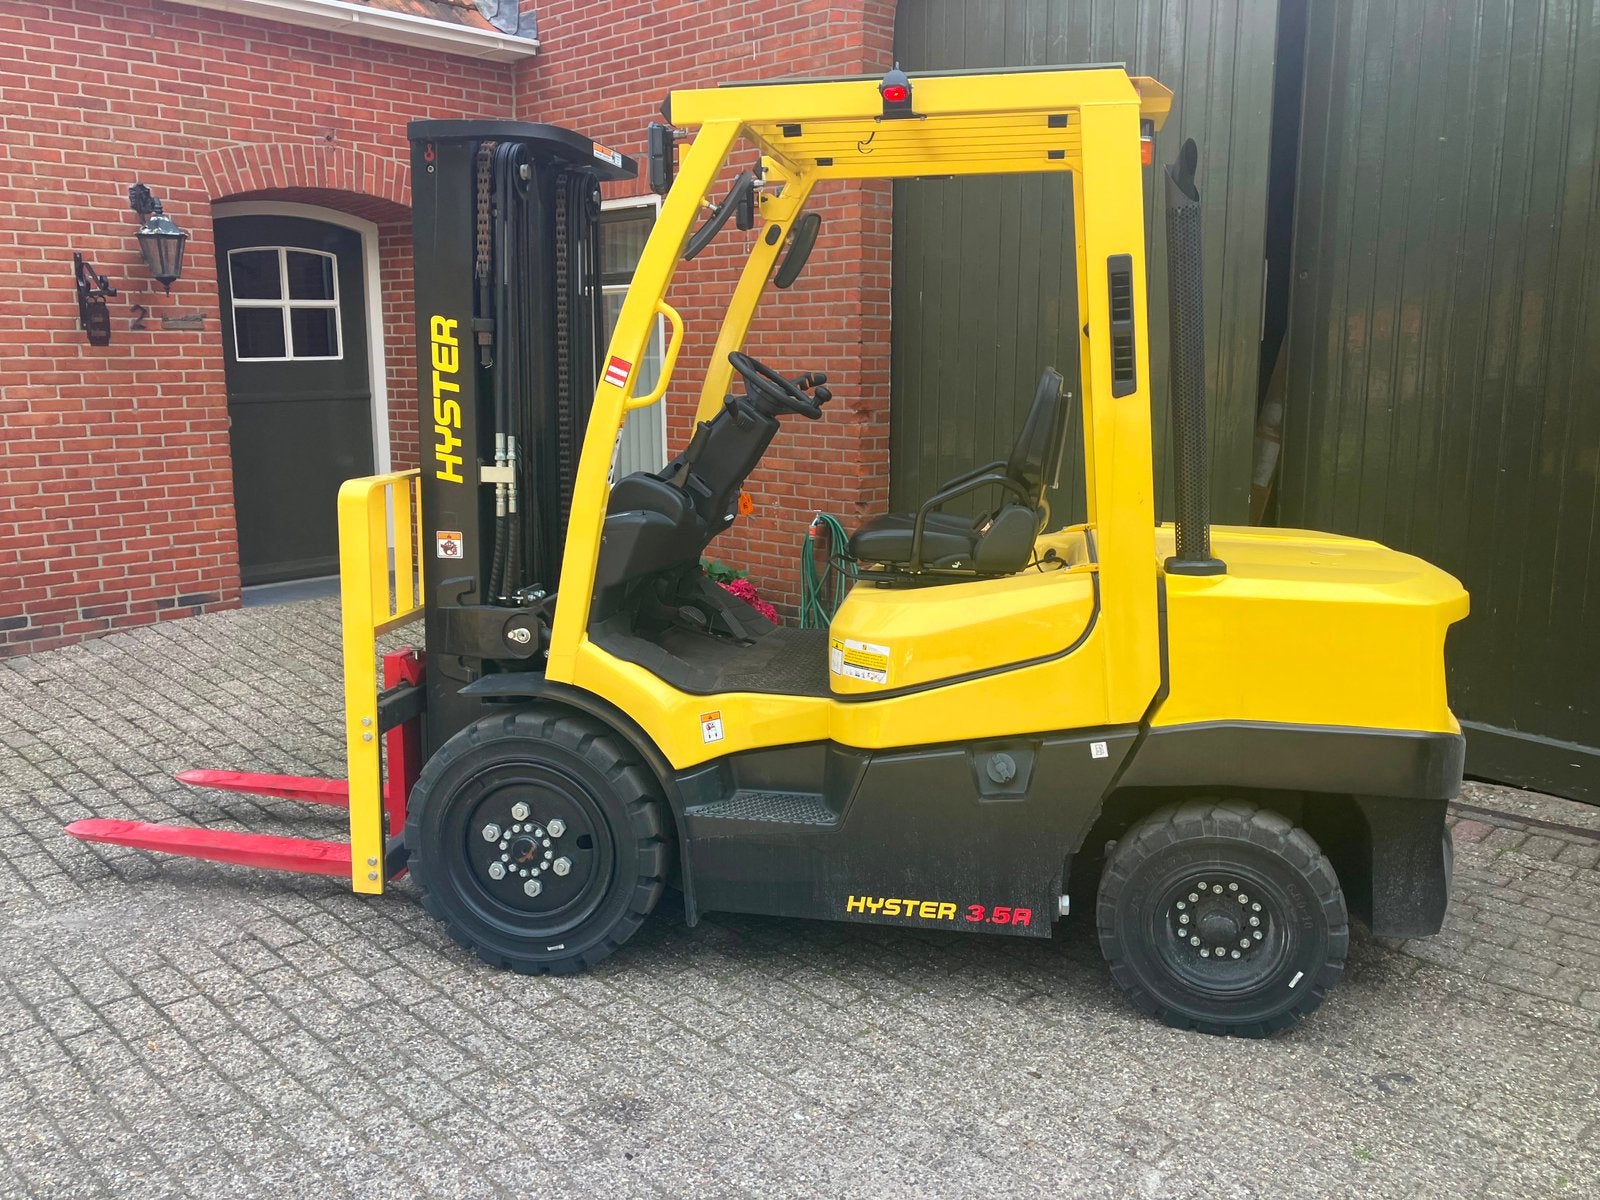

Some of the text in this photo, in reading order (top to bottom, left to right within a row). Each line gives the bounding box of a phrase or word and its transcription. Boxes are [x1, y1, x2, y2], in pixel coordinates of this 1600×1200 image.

[130, 304, 147, 330] 2
[430, 315, 463, 483] HYSTER
[847, 895, 957, 920] HYSTER
